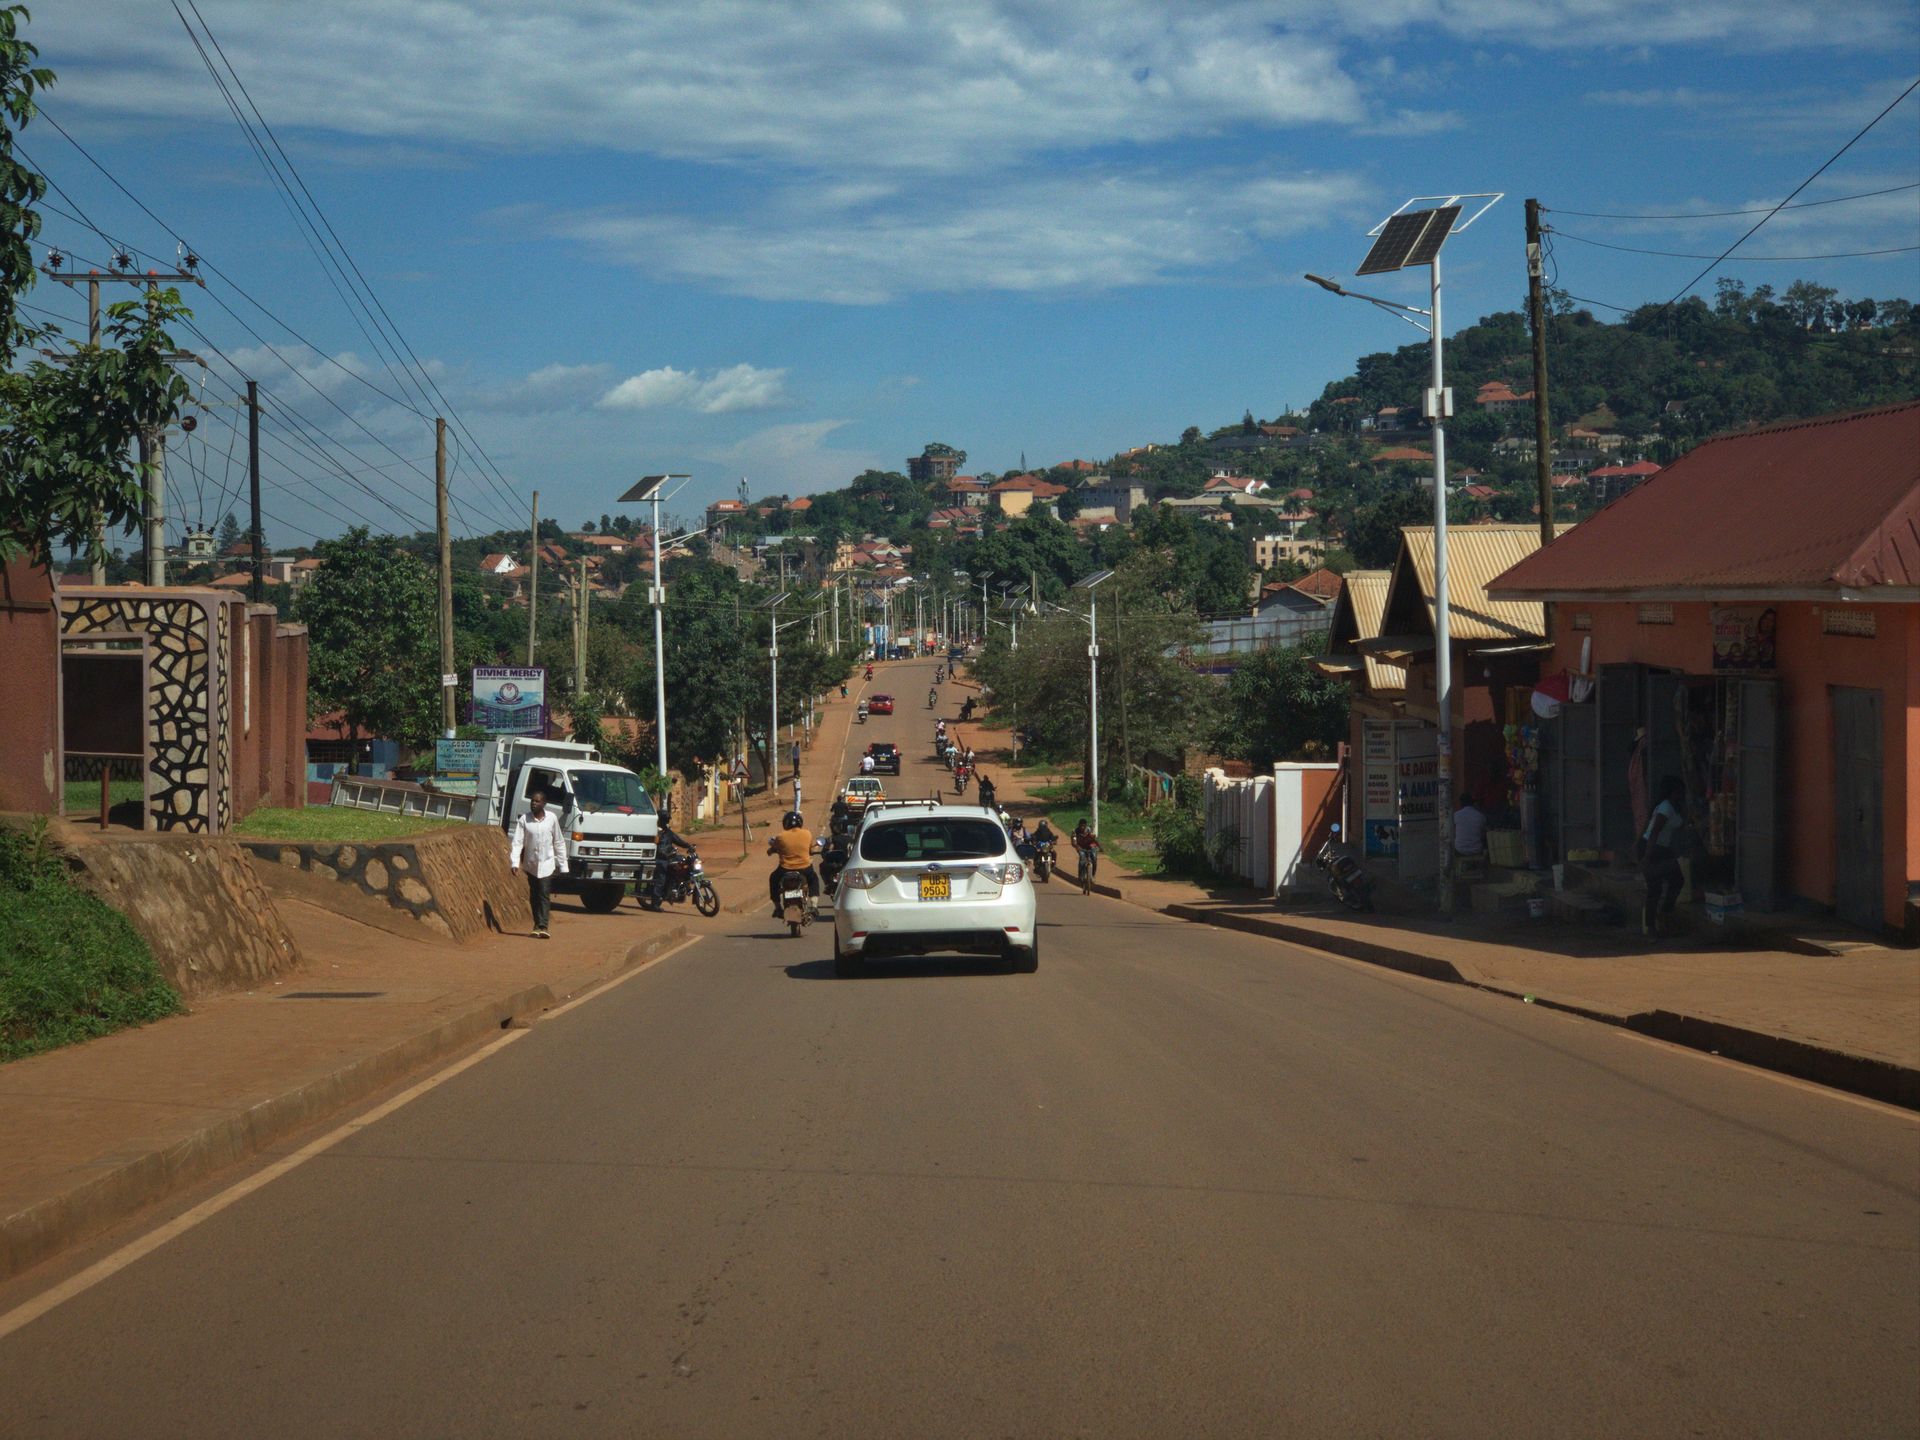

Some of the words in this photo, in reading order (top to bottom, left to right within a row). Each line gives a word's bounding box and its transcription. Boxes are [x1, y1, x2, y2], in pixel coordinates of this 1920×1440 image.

[476, 669, 508, 677] DIVINE
[509, 669, 543, 677] MERCY
[1413, 760, 1439, 776] DAIRY
[929, 875, 947, 885] UBJ
[923, 886, 947, 896] 950J
